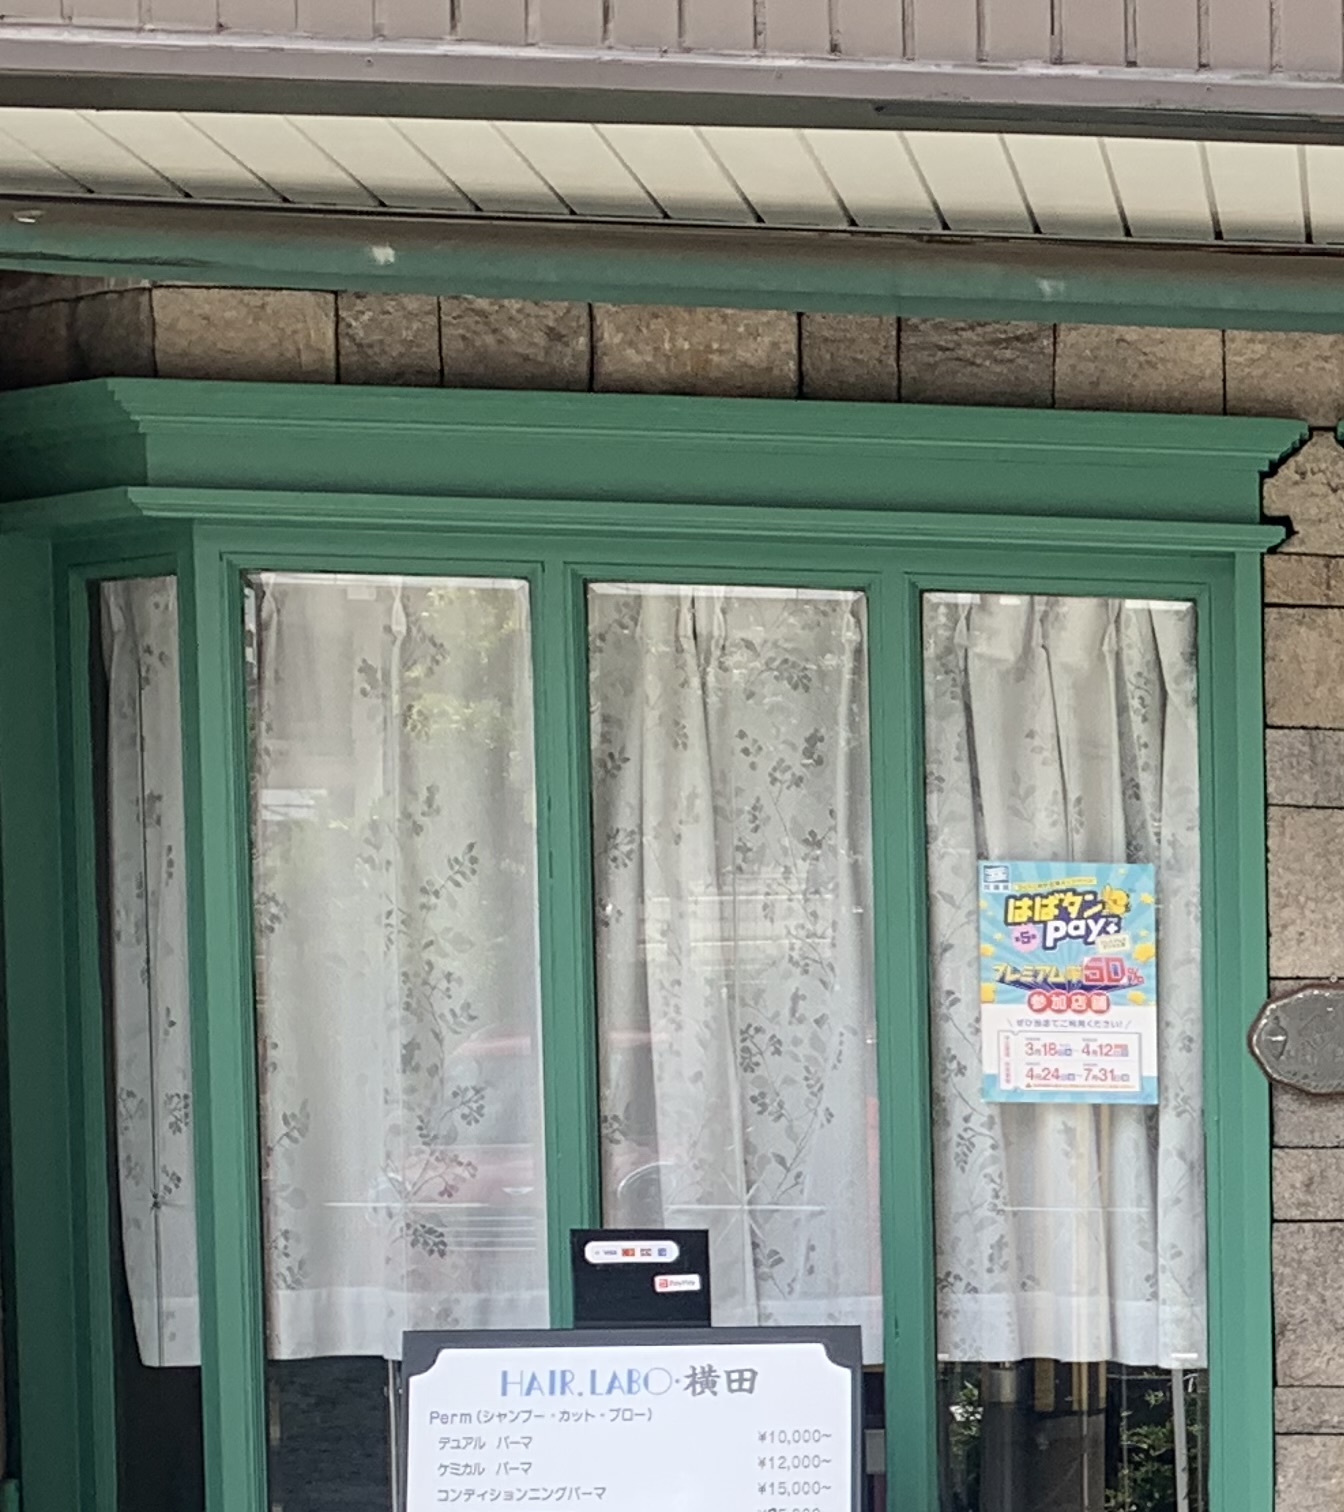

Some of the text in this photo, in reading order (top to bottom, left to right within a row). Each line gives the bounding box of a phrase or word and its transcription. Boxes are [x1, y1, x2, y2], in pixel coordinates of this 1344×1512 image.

[1007, 891, 1103, 923] はばタン
[437, 1462, 485, 1477] ケミカル
